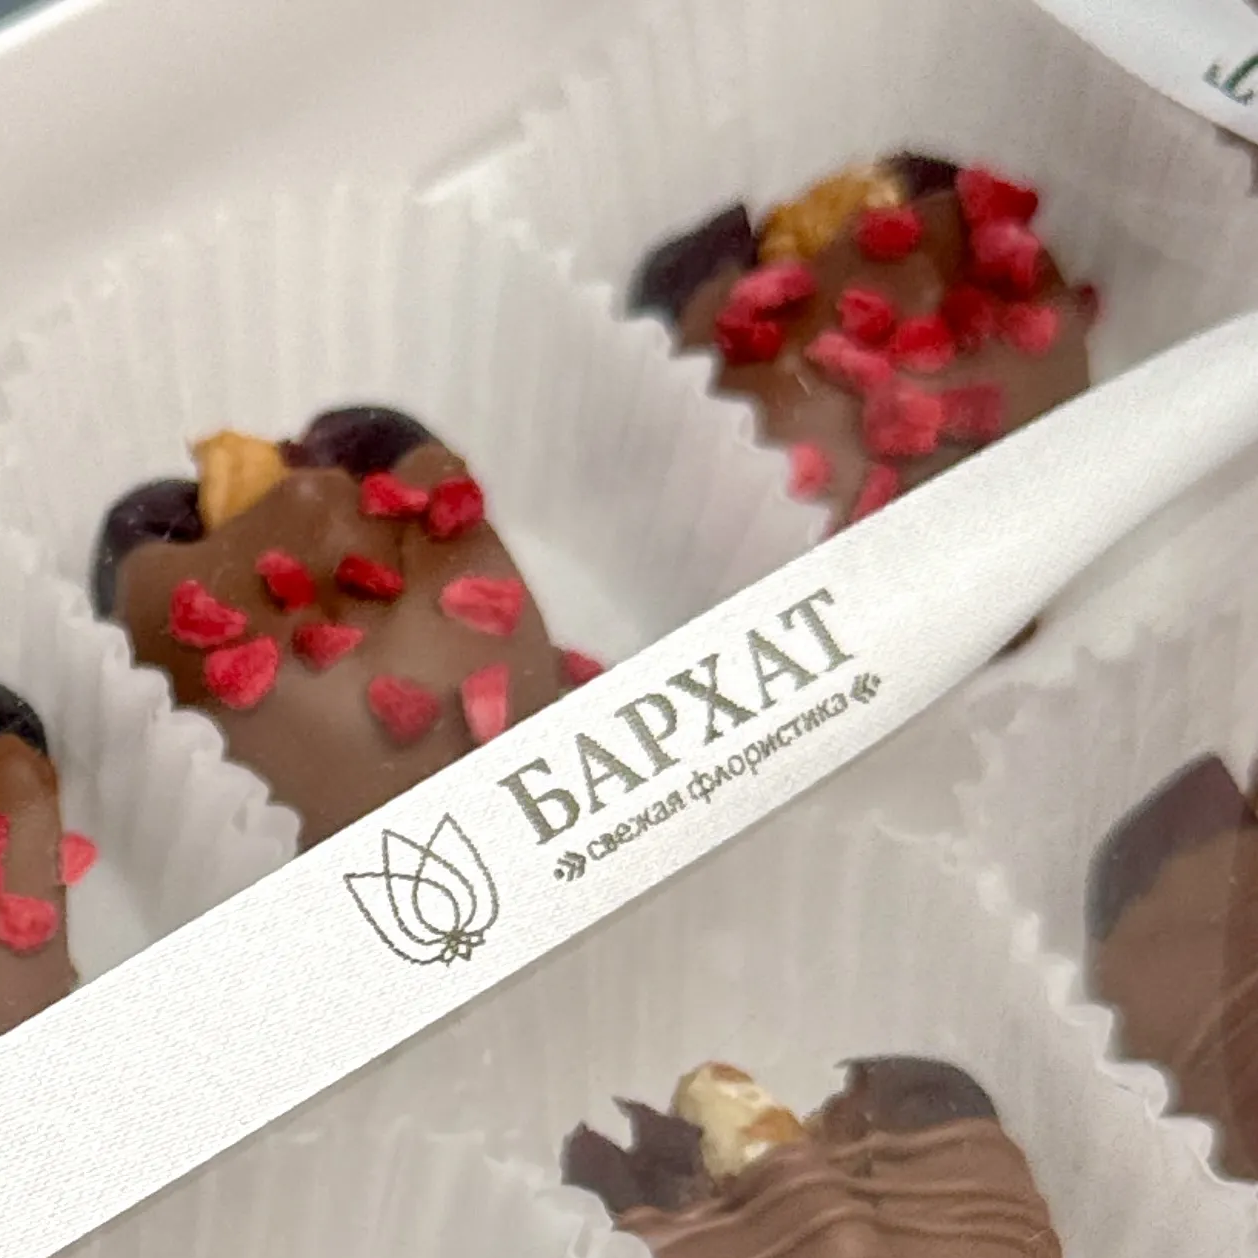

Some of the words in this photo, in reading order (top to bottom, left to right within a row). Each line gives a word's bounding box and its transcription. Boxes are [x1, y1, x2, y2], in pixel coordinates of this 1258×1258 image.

[497, 589, 854, 845] БАРХАТ
[587, 790, 685, 861] свежая
[687, 692, 849, 802] флористика
